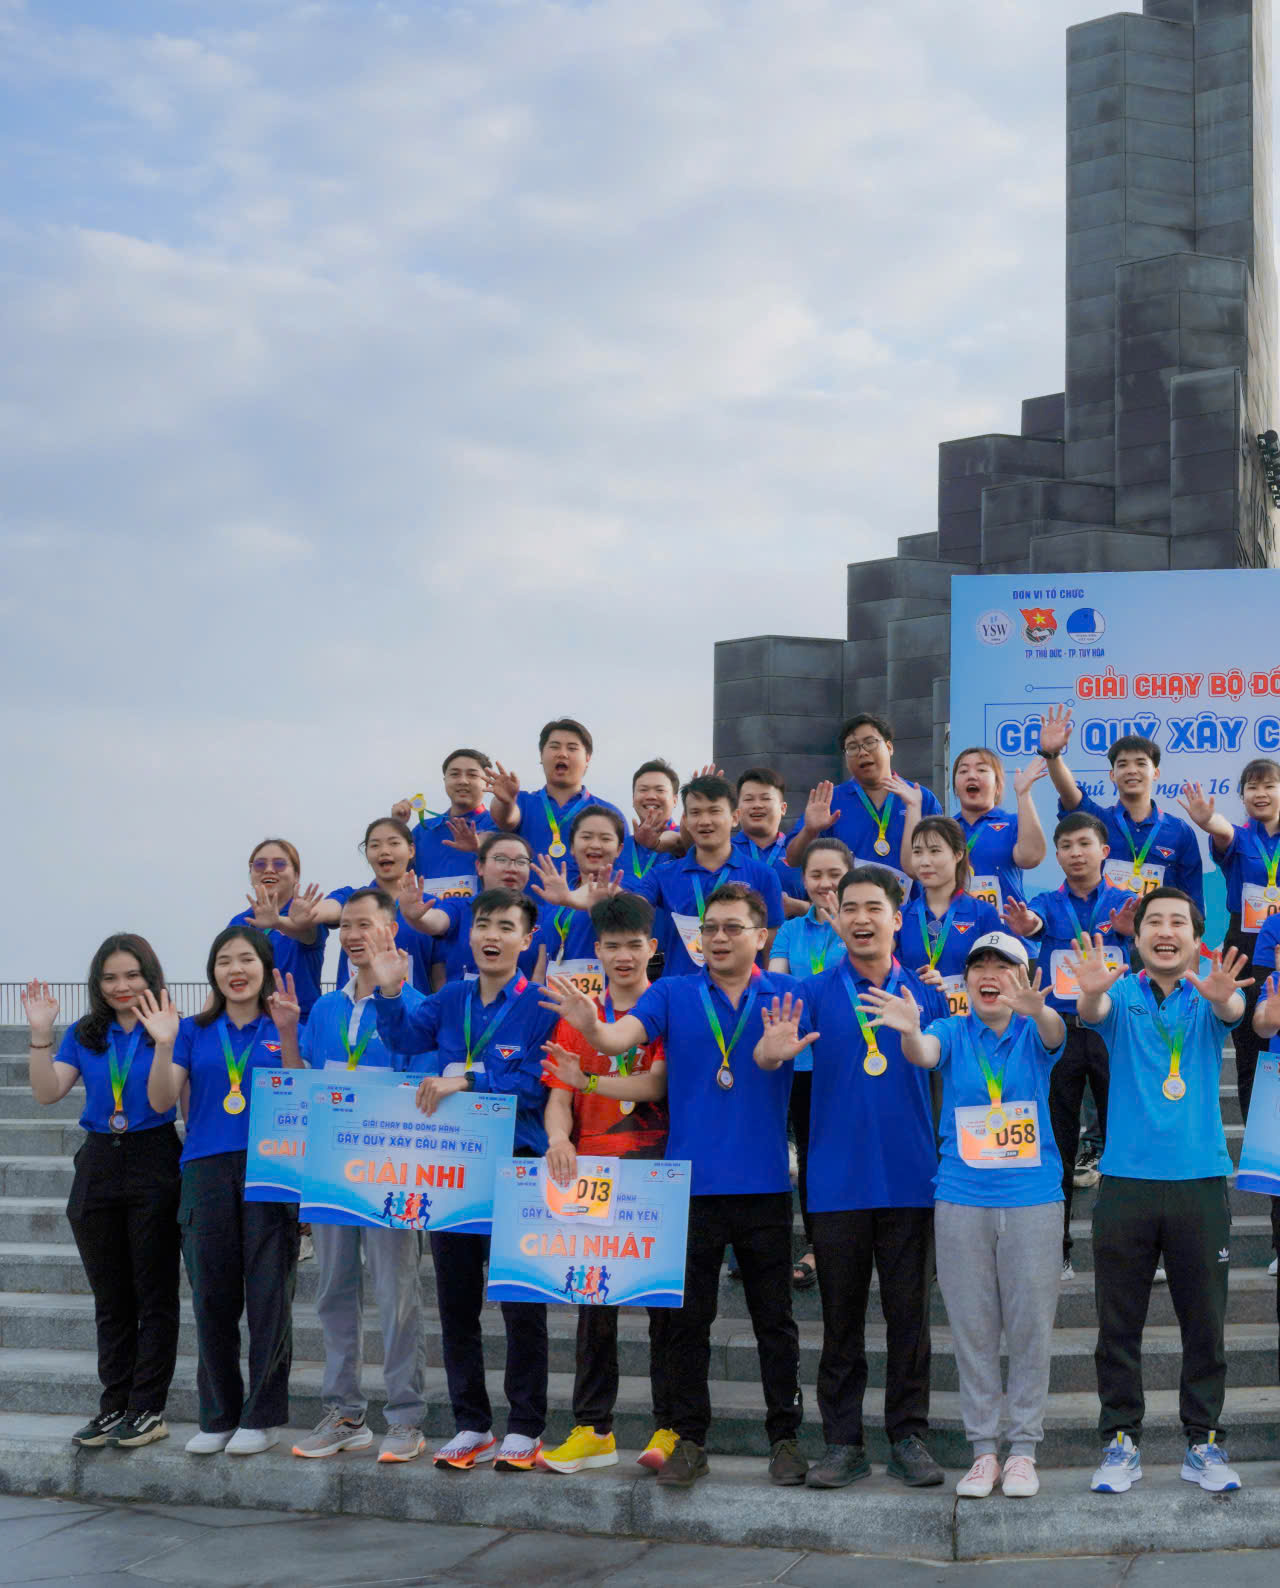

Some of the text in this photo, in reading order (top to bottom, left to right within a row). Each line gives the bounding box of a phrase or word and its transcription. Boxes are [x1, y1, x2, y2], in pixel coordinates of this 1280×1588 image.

[982, 623, 1008, 637] YSW
[1077, 666, 1127, 699] GIẢI
[1134, 674, 1203, 702] CHẠY
[1208, 668, 1245, 702] BỘ
[1167, 712, 1247, 754] XÂY
[1208, 778, 1230, 795] 16
[441, 1139, 456, 1151] AN
[995, 1123, 1036, 1147] 058
[344, 1155, 465, 1189] GIẢI NHÌ
[578, 1178, 611, 1202] 013
[619, 1209, 633, 1221] AN
[520, 1229, 577, 1257] GIẢI
